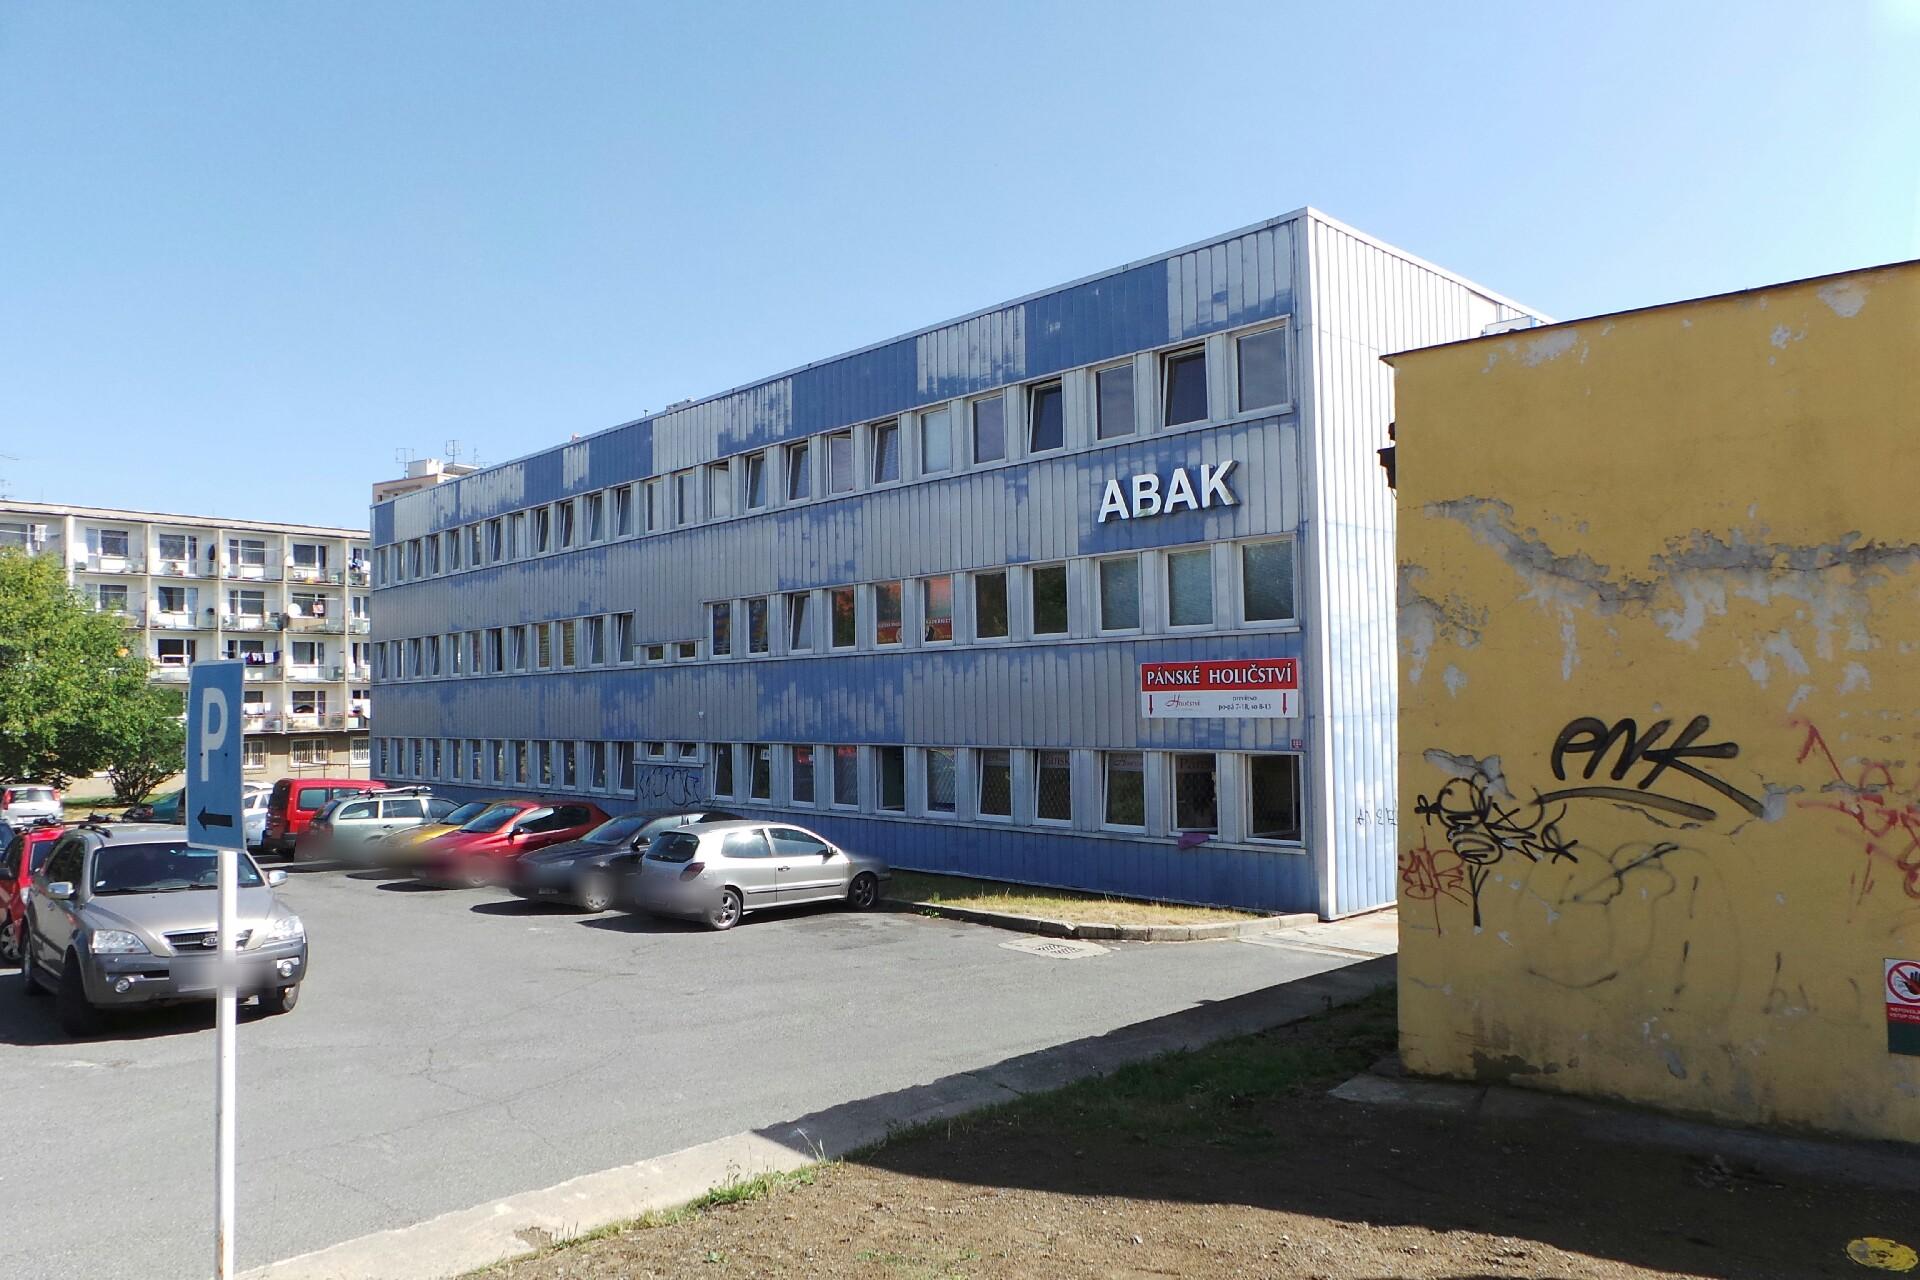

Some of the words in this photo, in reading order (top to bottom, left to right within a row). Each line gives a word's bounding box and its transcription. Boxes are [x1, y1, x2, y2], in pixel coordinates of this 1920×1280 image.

[1098, 459, 1240, 523] ABAK
[1147, 665, 1200, 685] PÁNSKÉ
[1209, 663, 1292, 684] HOLIČSTVÍ
[201, 687, 228, 782] P
